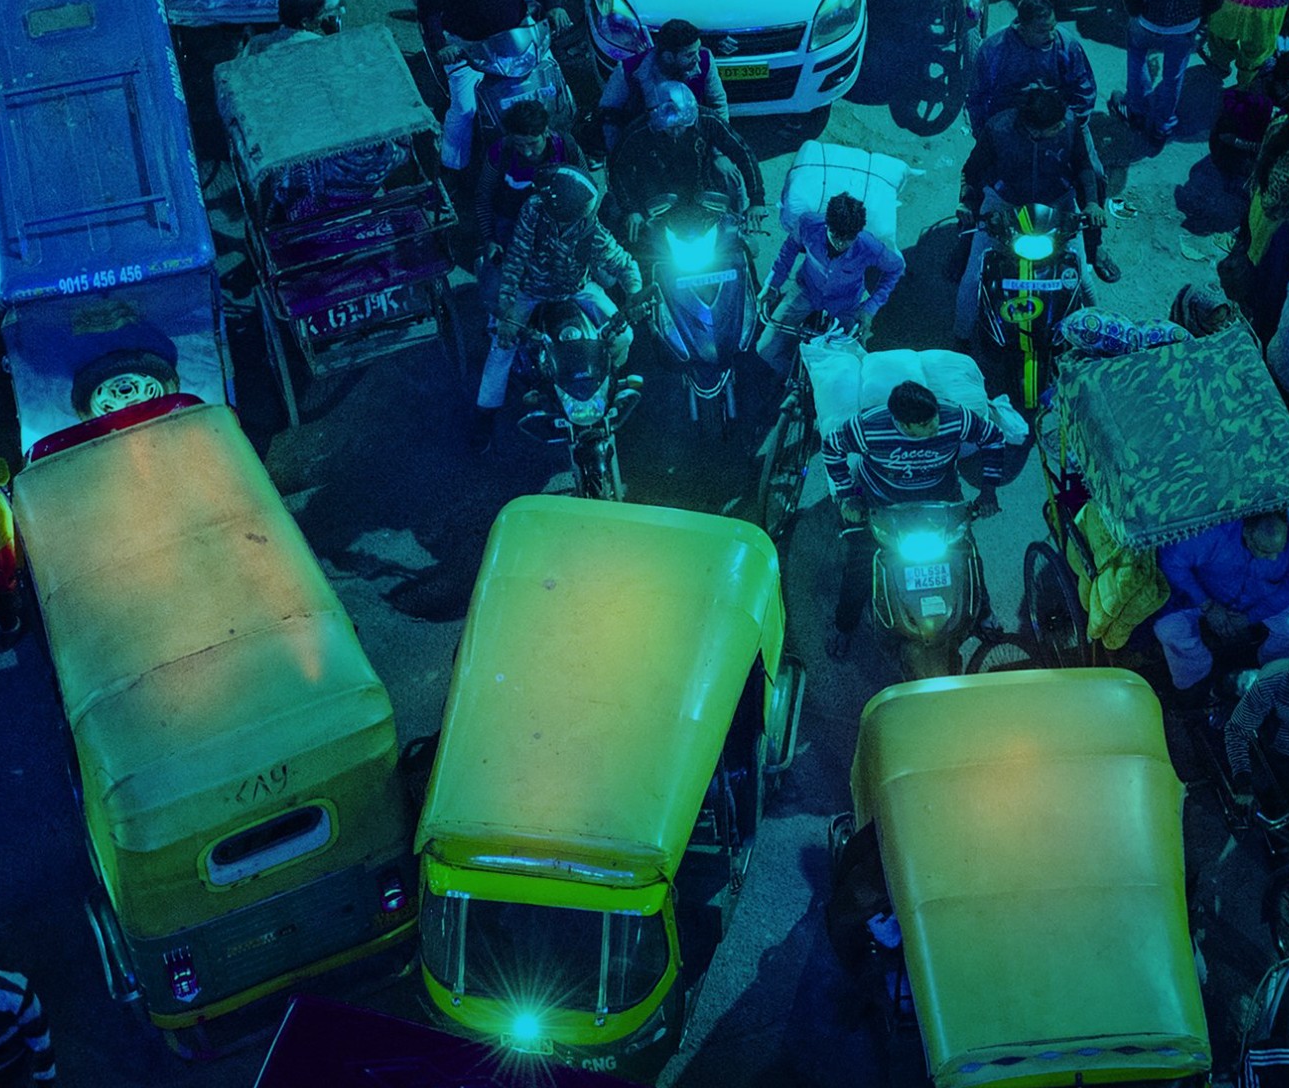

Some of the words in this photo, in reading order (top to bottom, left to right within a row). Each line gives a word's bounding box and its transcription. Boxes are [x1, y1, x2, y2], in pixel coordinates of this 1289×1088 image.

[724, 68, 741, 77] DT
[742, 66, 768, 77] 3302
[59, 278, 89, 295] 9015
[93, 269, 116, 289] 456
[119, 264, 143, 284] 456
[888, 446, 940, 466] Soccer
[582, 1055, 617, 1072] CNG
